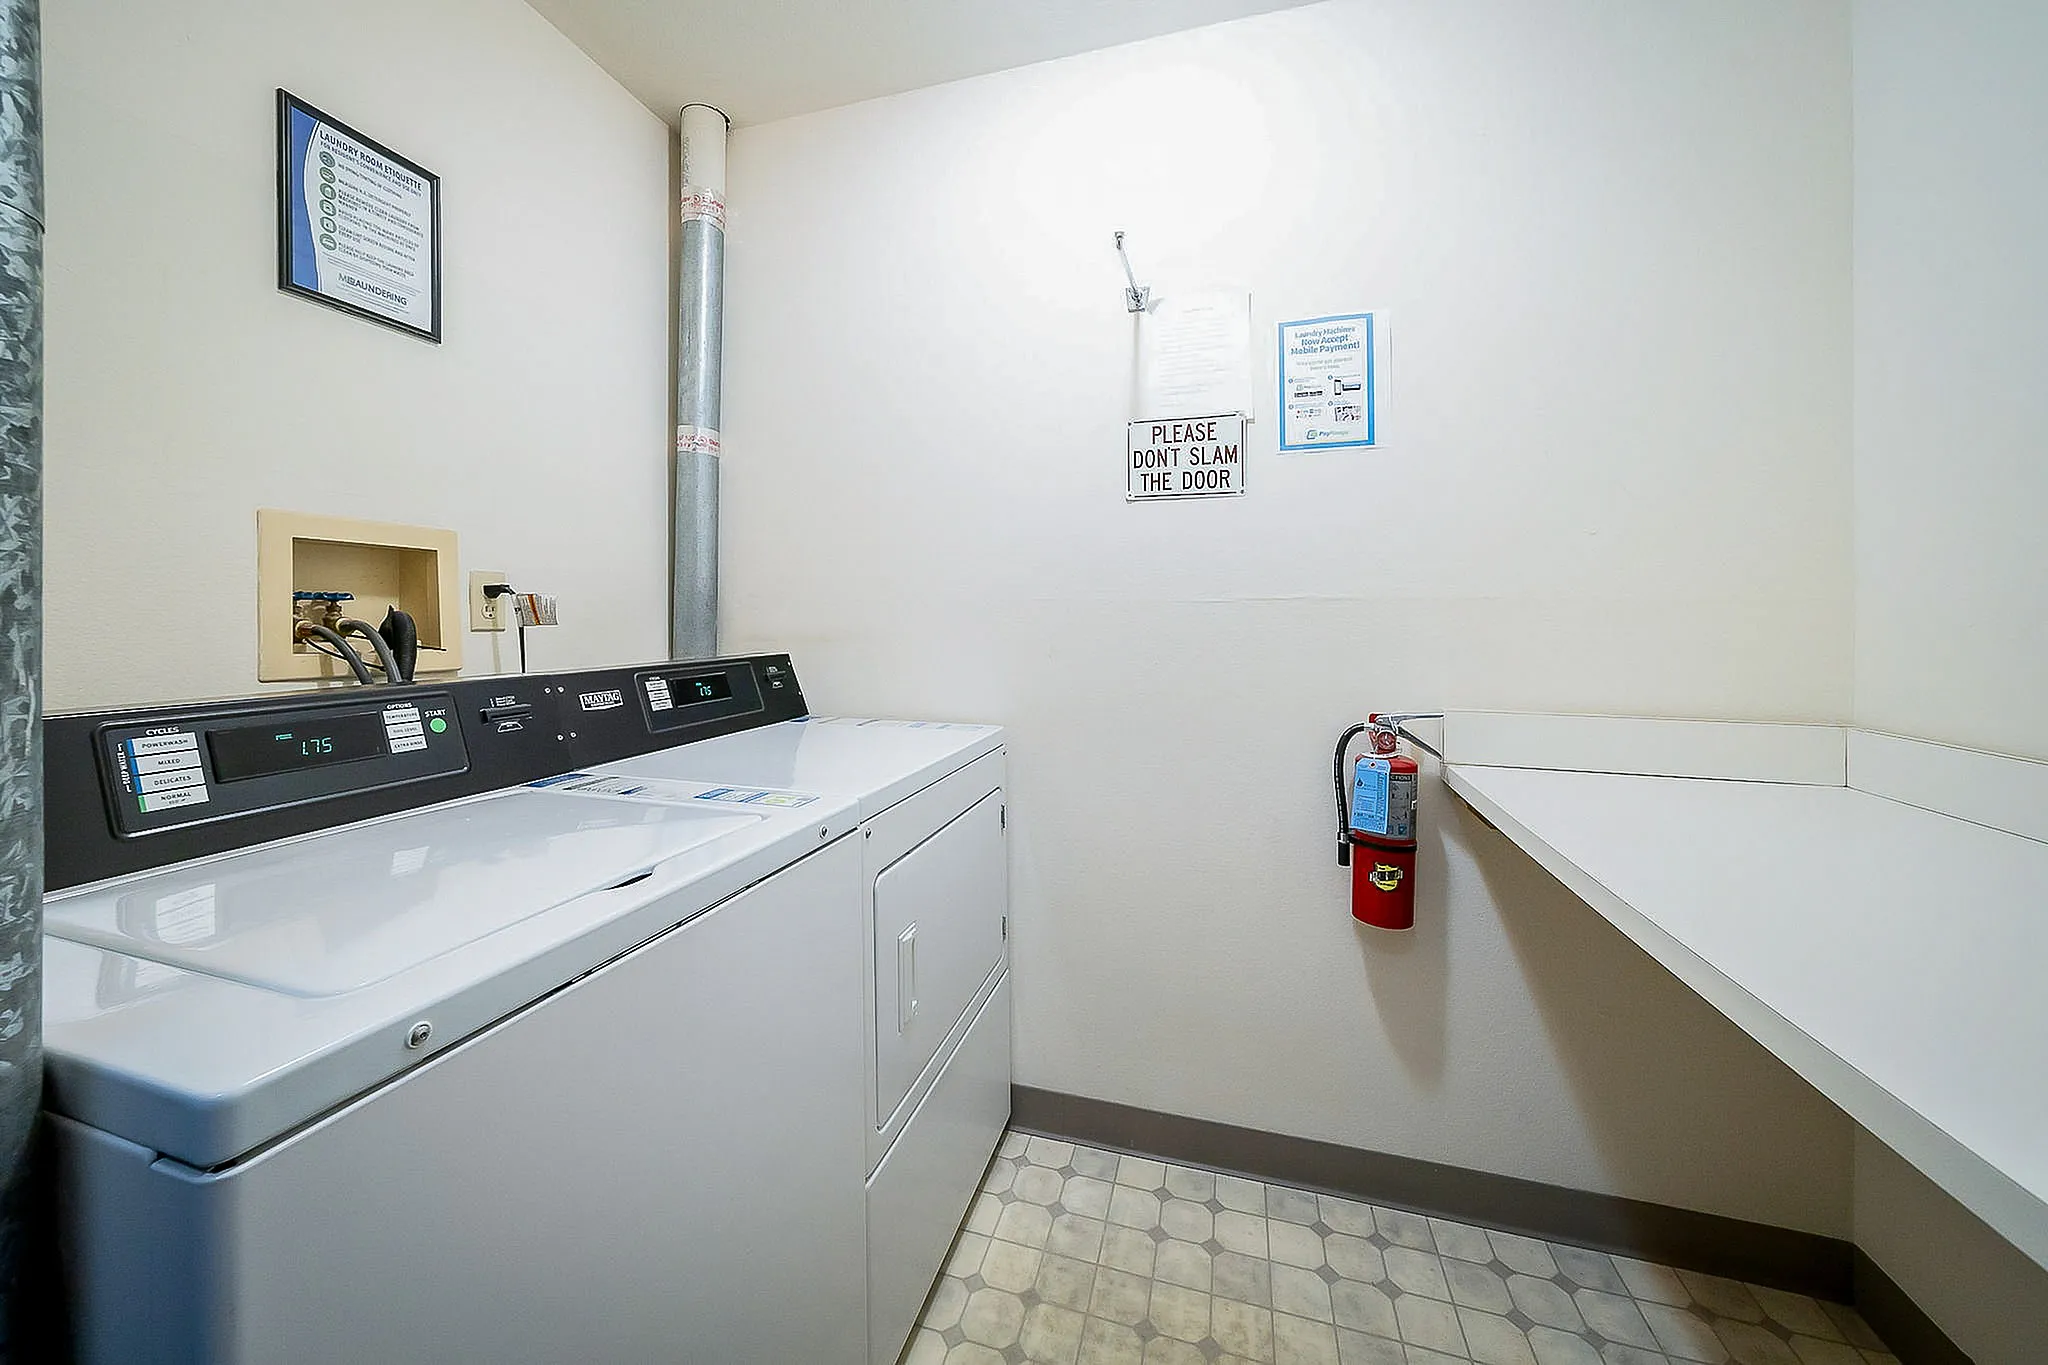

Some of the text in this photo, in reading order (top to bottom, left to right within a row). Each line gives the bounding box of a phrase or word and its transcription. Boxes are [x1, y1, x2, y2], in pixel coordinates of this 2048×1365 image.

[319, 129, 358, 158] LAUNDRY
[360, 151, 383, 171] ROOM
[384, 164, 422, 192] ETIQUETTE
[1295, 325, 1356, 338] Laundry Machines
[1301, 334, 1349, 346] Now Accept
[1290, 341, 1360, 355] Mobile Payment!
[1152, 422, 1217, 444] PLEASE
[1133, 444, 1238, 469] DON'T SLAM
[1140, 469, 1231, 491] THE DOOR
[583, 692, 620, 705] MAYTAG
[386, 702, 413, 710] OPTIONS
[424, 708, 447, 718] START
[145, 726, 180, 736] CYCLES
[141, 739, 189, 749] POWERWASH
[302, 737, 333, 756] 1.75
[157, 758, 181, 766] MIXED
[153, 775, 192, 786] DELICATES
[160, 791, 192, 801] NORMAL
